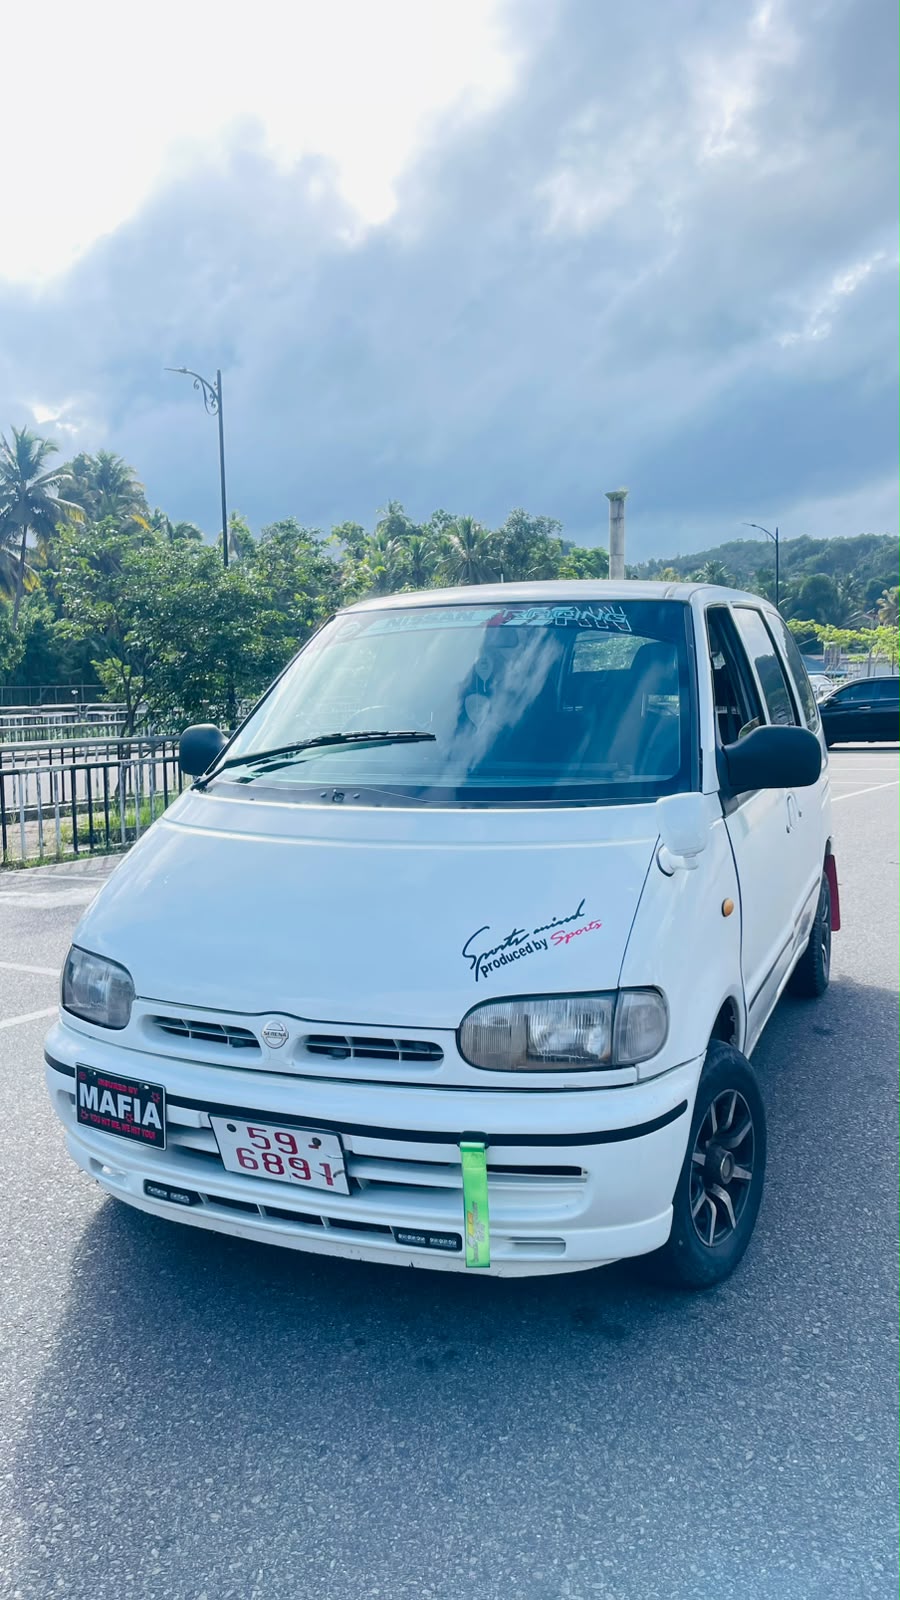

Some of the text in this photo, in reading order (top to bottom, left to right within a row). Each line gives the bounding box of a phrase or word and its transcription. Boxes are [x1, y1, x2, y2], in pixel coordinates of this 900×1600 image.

[462, 925, 530, 982] Sports
[480, 919, 602, 978] produced by Sports
[263, 1030, 287, 1038] SERENA
[79, 1082, 162, 1130] MAFIA
[246, 1126, 298, 1155] 59
[236, 1147, 334, 1187] 6891
